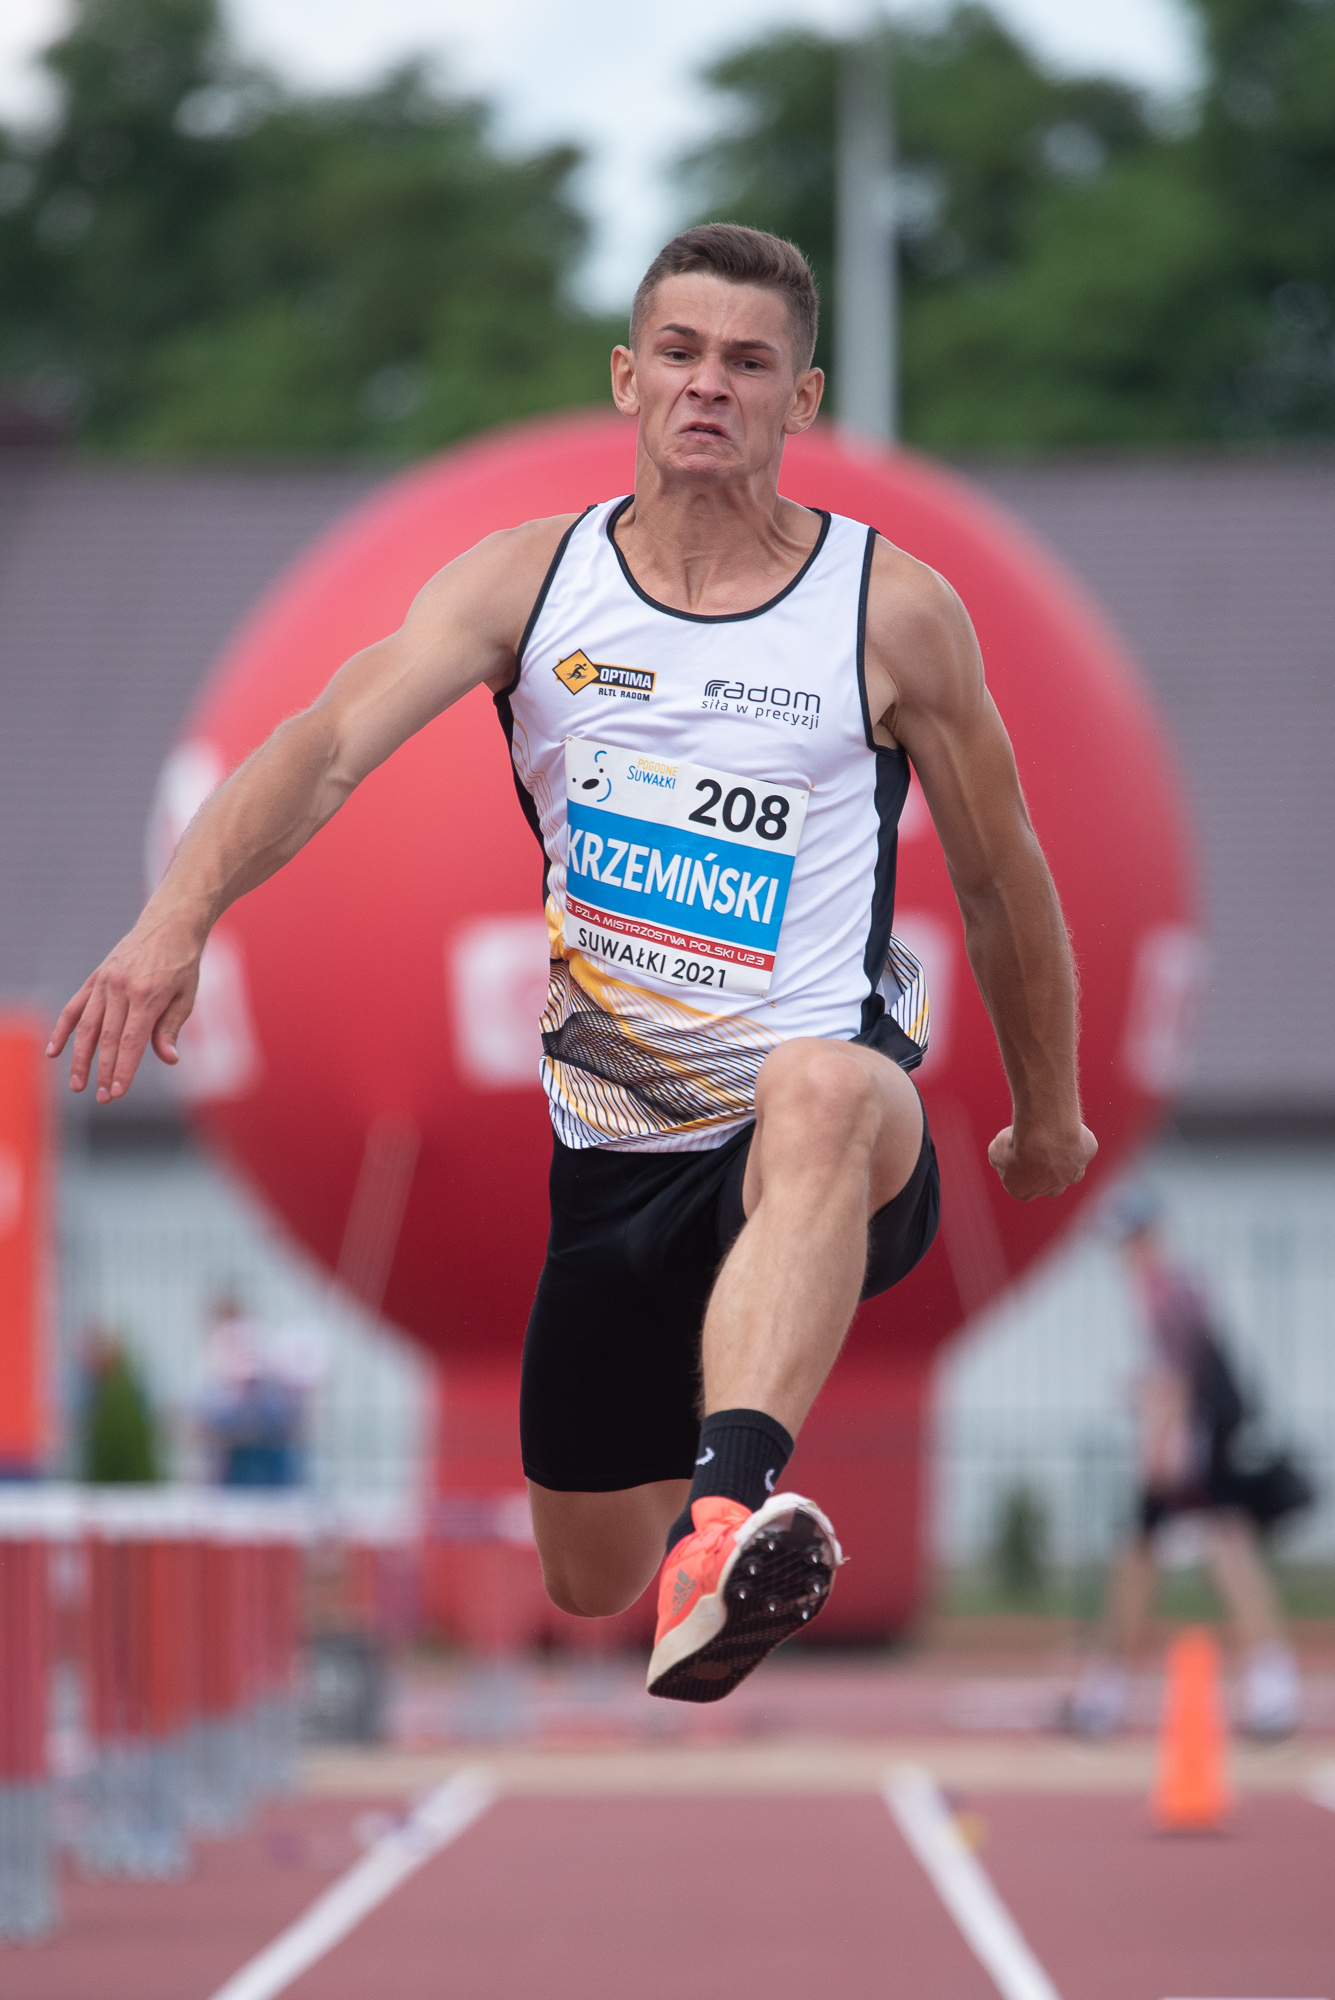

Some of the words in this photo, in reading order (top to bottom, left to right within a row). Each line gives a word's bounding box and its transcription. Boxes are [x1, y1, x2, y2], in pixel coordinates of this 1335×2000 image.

[598, 687, 616, 697] RLTL
[620, 690, 650, 701] RADOM
[599, 668, 652, 689] OPTIMA
[701, 699, 729, 711] siła
[736, 704, 748, 714] w
[755, 706, 820, 730] precyzji
[637, 759, 678, 777] POGODNE
[688, 779, 790, 841] 208
[567, 824, 779, 924] KRZEMIŃSKI
[574, 906, 600, 924] PZLA
[602, 917, 686, 948] MISTRZOSTWA
[689, 941, 735, 959] POLSKI
[737, 952, 765, 966] U23
[578, 927, 666, 974] SUWAŁKI
[671, 958, 726, 989] 2021
